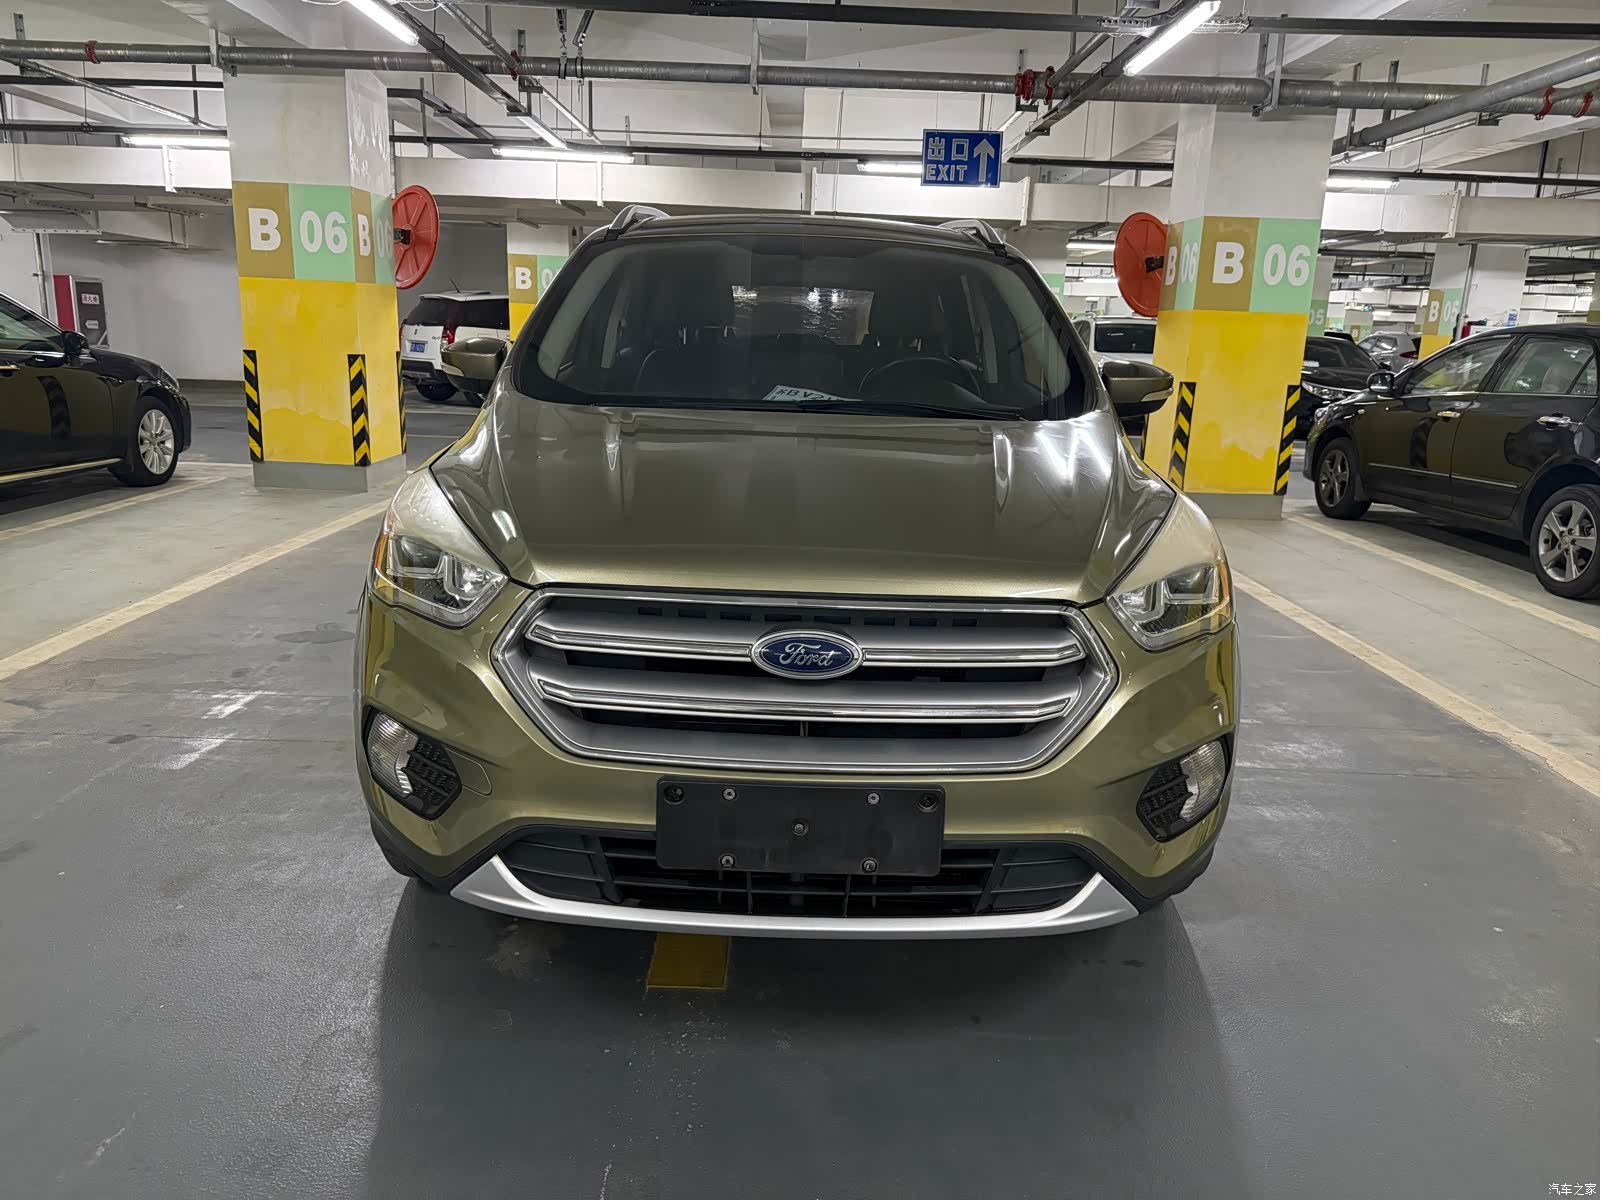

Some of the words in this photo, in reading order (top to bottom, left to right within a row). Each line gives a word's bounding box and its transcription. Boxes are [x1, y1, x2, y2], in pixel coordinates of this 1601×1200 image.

[927, 137, 969, 161] 出口
[926, 164, 967, 181] EXIT
[248, 207, 281, 251] B
[300, 210, 348, 254] 06
[357, 213, 371, 256] B
[1165, 246, 1177, 285] B
[1180, 242, 1198, 283] 06
[1212, 241, 1245, 284] B
[1263, 244, 1311, 286] 06
[514, 266, 532, 289] B
[541, 268, 561, 289] 0
[1428, 301, 1439, 322] B
[779, 642, 835, 666] Ford
